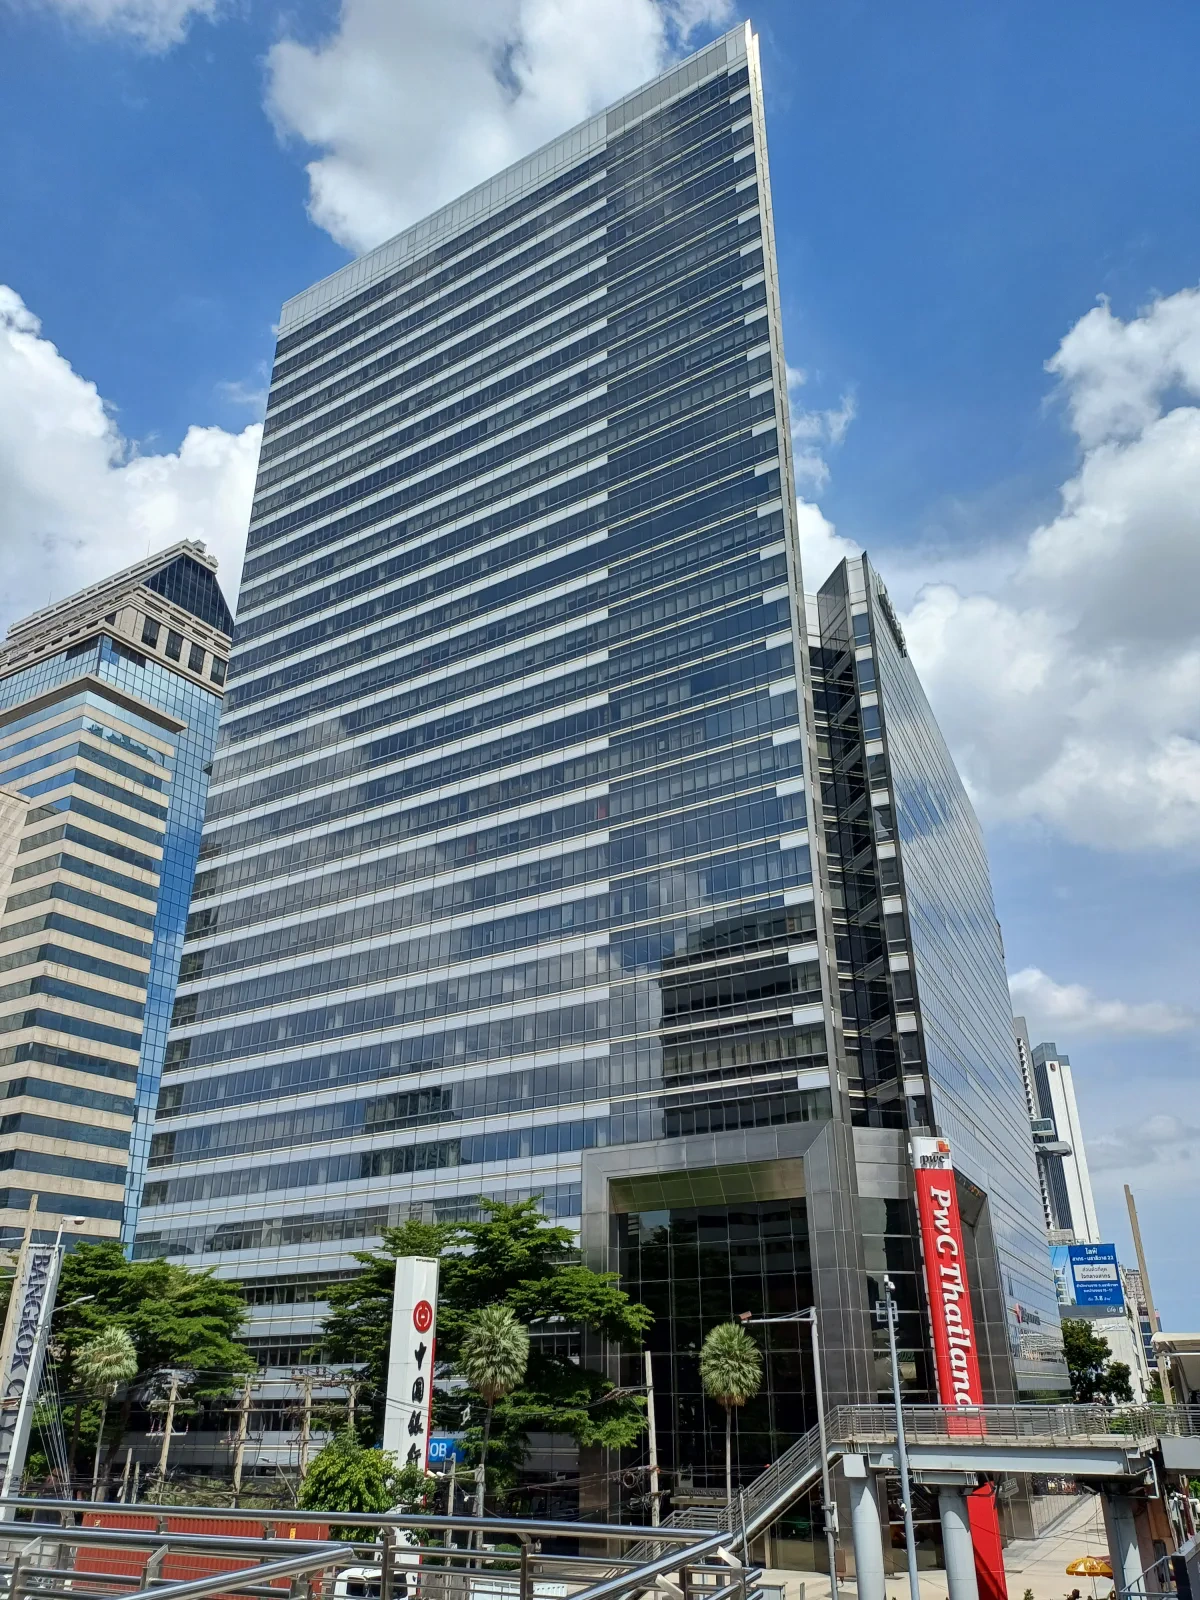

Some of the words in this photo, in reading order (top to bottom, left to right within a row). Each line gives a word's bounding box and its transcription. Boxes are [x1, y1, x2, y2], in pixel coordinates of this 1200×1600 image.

[920, 1154, 946, 1165] pwc
[930, 1186, 959, 1256] PwC
[10, 1253, 52, 1374] BANGKOK
[940, 1263, 979, 1411] Thailand
